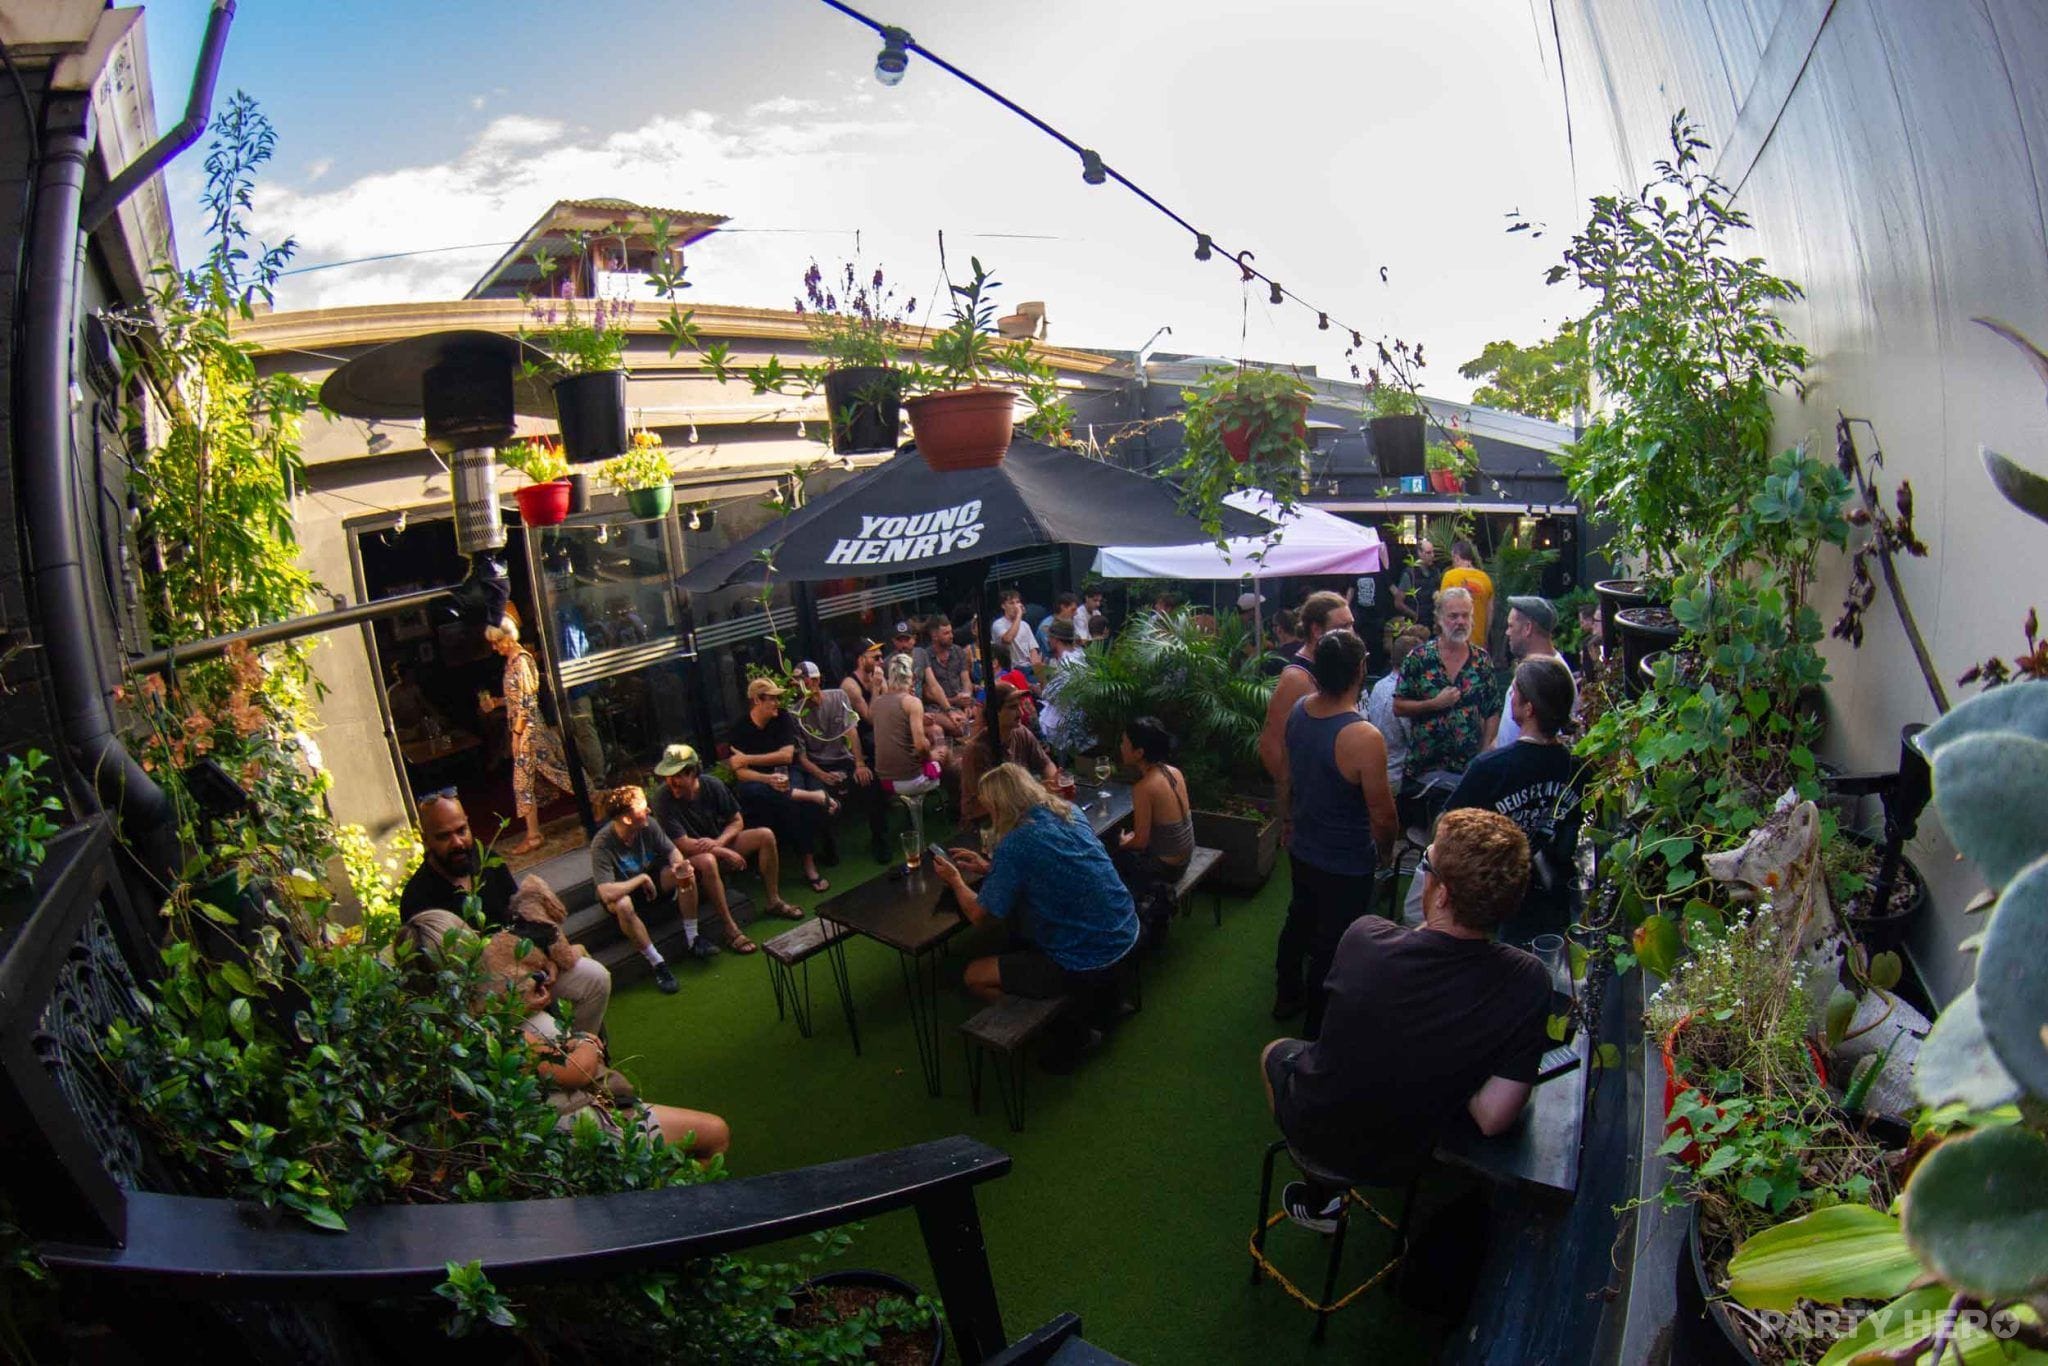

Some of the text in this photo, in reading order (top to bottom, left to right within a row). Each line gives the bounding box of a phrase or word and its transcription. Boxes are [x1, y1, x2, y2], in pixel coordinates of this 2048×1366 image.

[858, 499, 983, 539] YOUNG
[824, 522, 985, 564] HENRYS
[1495, 788, 1529, 815] DEUS
